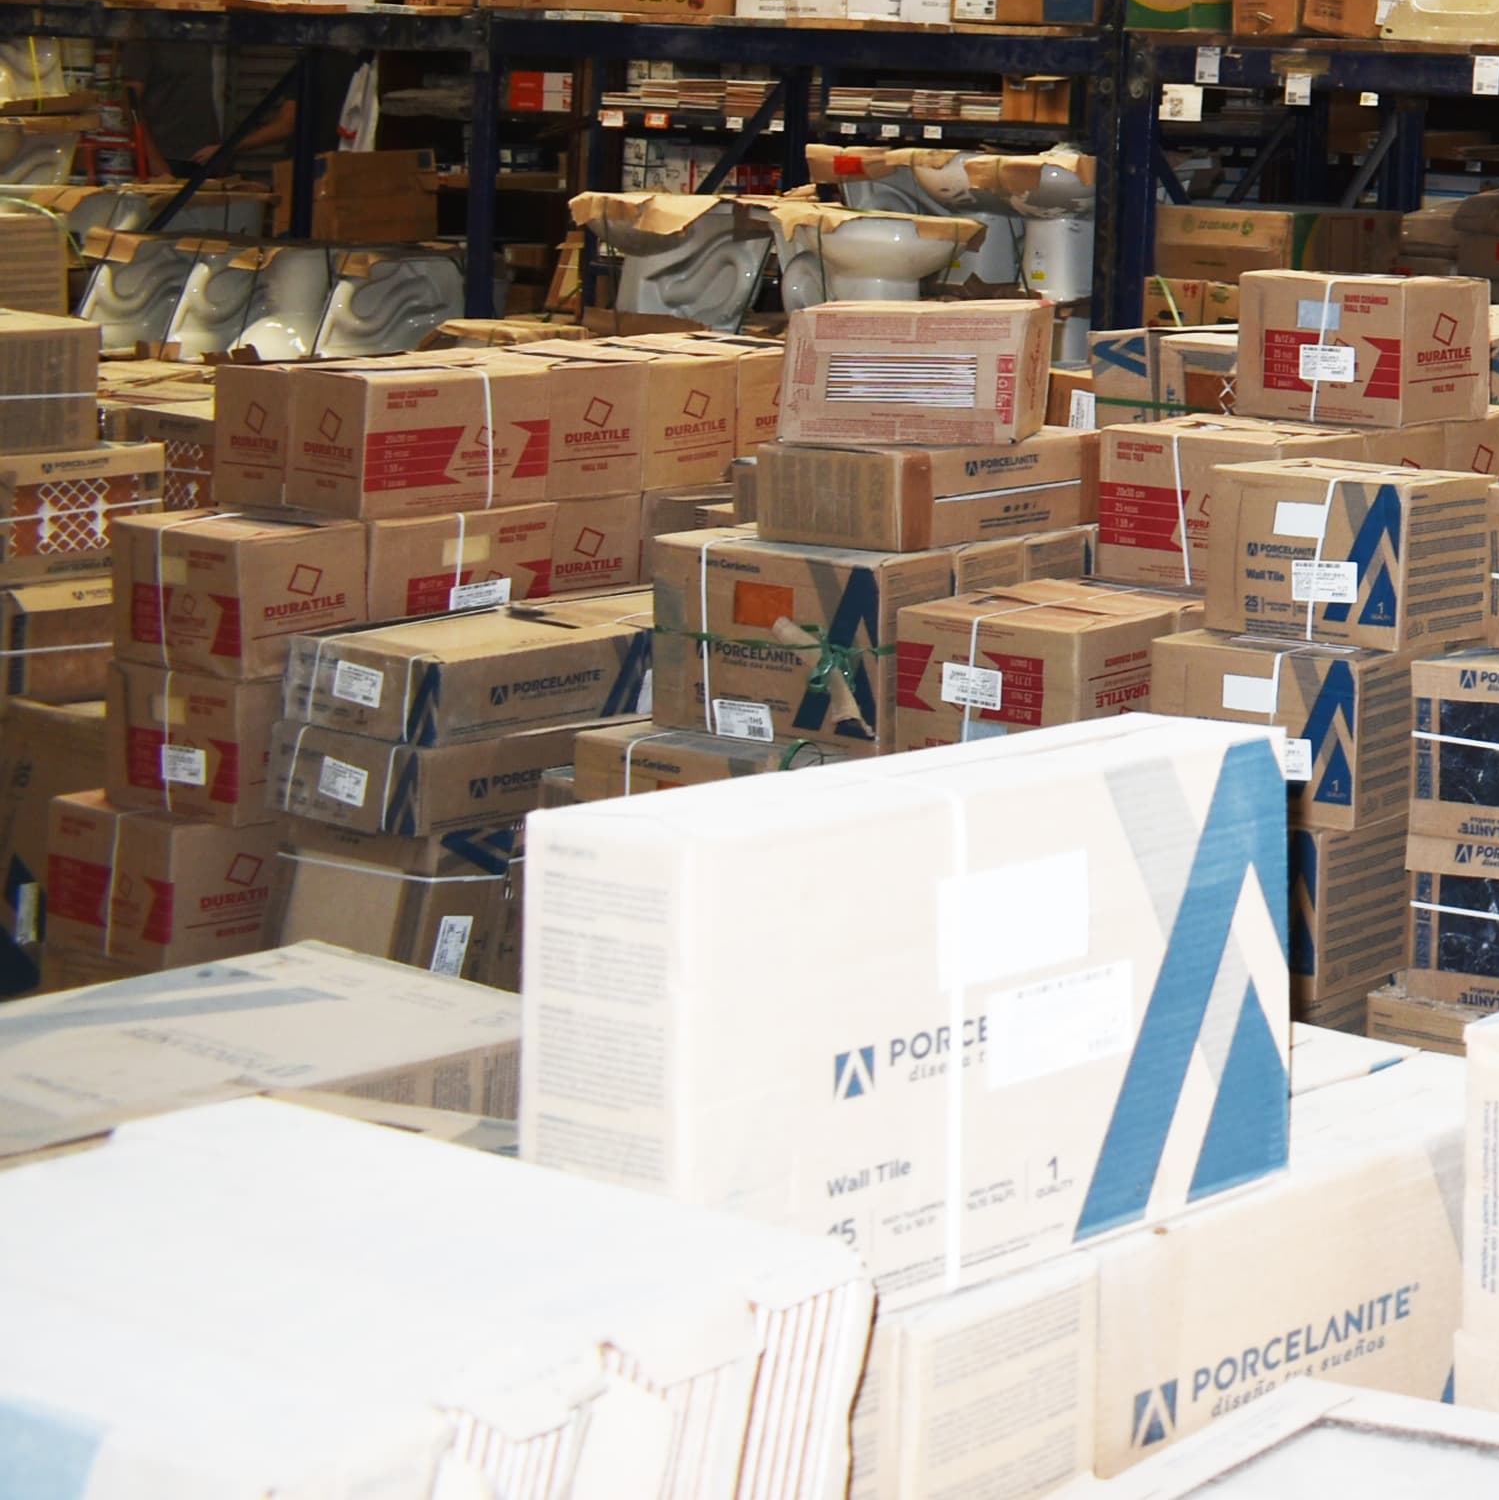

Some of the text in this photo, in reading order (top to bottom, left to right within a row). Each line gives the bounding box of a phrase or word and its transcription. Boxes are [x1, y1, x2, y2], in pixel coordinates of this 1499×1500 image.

[1417, 346, 1472, 363] DURATILE
[565, 428, 630, 445] DURATILE
[664, 418, 727, 437] DURATILE
[555, 557, 623, 576] DURATILE
[1246, 568, 1285, 582] Wall Tile
[263, 593, 346, 621] DURATILE
[1245, 595, 1259, 607] 25
[1378, 602, 1384, 614] 1
[512, 670, 602, 694] PORCELANITE
[826, 1158, 912, 1198] Wall Tile
[1047, 1156, 1058, 1180] 1
[1034, 1178, 1075, 1199] QUALITY
[1191, 1285, 1411, 1403] PORCELANITE
[1210, 1336, 1385, 1419] diseña sueños
